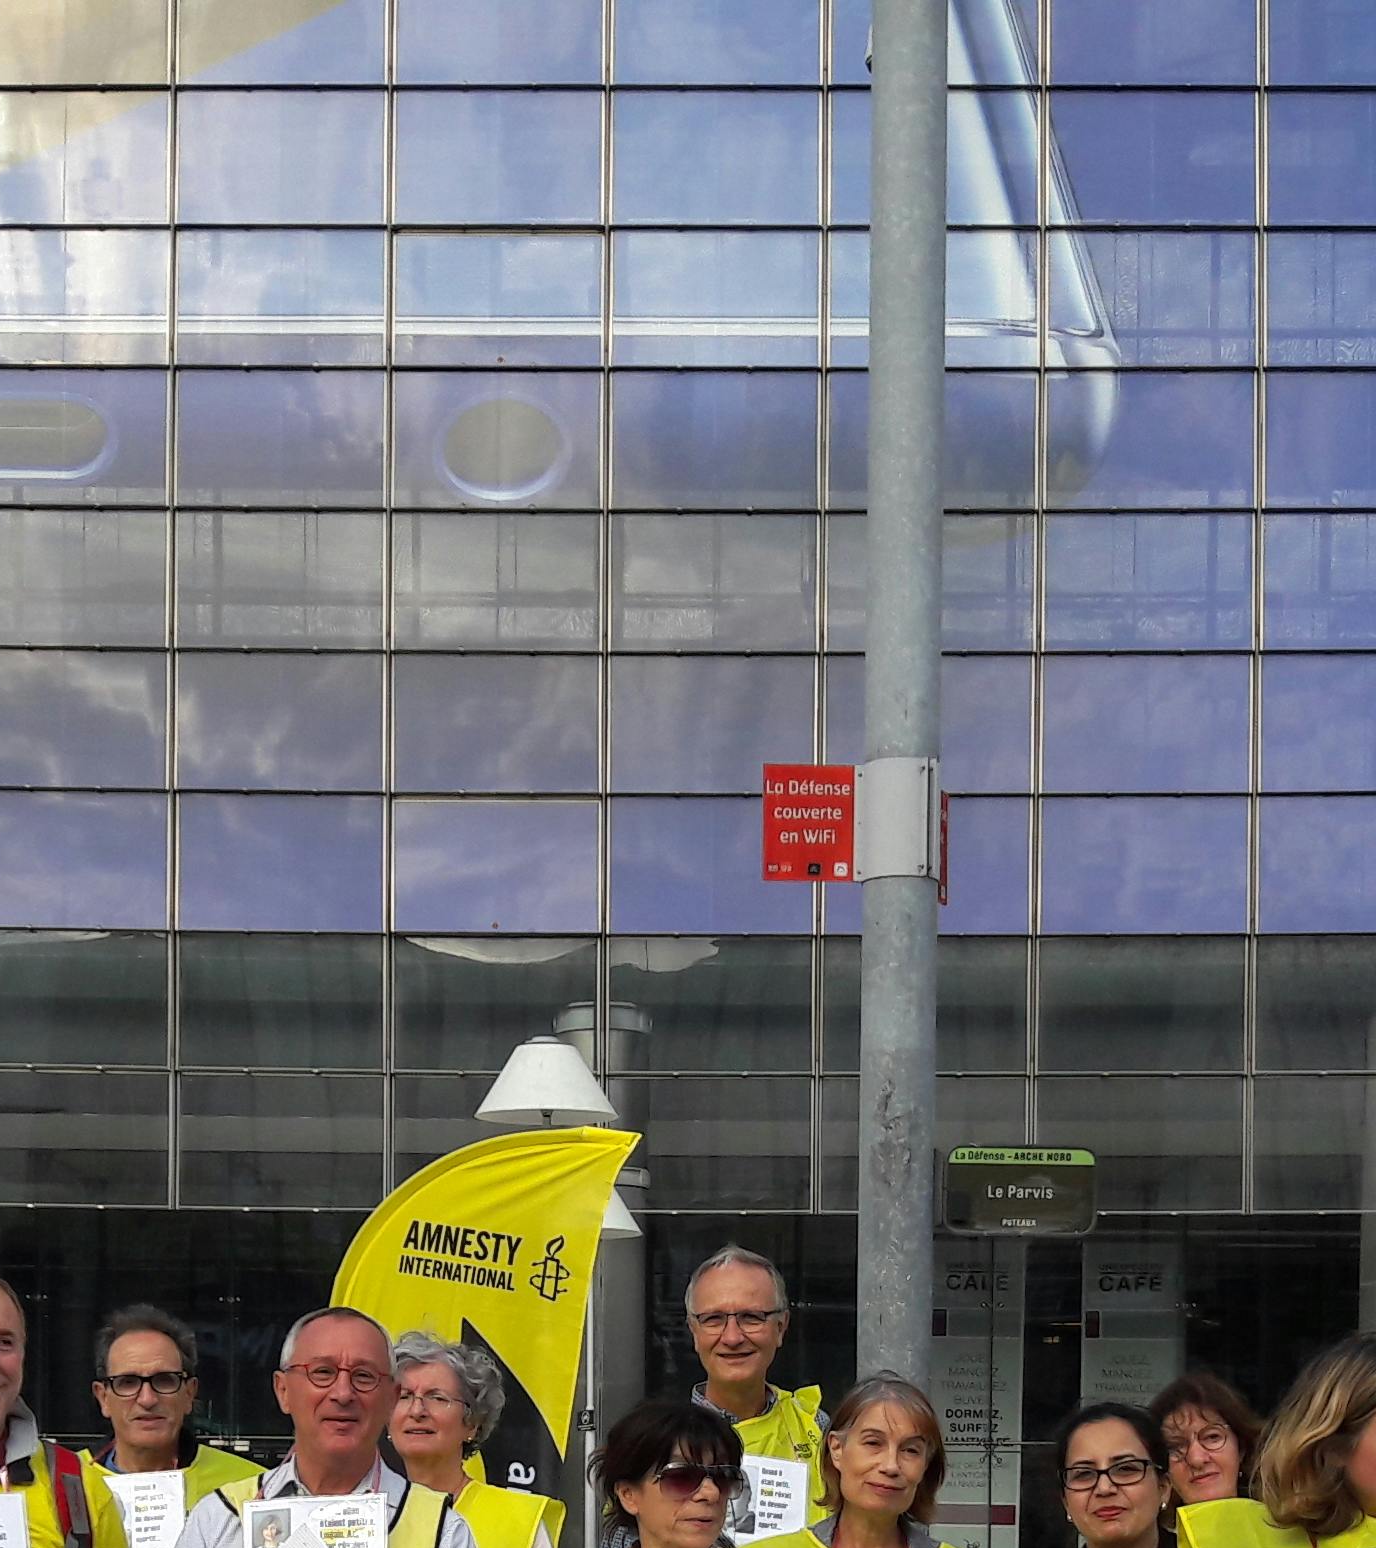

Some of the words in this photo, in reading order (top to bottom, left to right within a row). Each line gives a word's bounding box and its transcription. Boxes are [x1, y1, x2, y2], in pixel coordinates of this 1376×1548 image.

[766, 780, 784, 795] La
[788, 780, 850, 796] Défense
[774, 806, 843, 820] couverte
[780, 831, 799, 844] en
[802, 828, 836, 844] WiFi
[954, 1151, 966, 1160] La
[968, 1150, 1005, 1161] Défense
[1014, 1152, 1044, 1161] ARCHE
[987, 1185, 1004, 1199] Le
[1008, 1184, 1054, 1199] Parvis
[1002, 1218, 1037, 1227] PUTEAUX
[402, 1220, 523, 1266] AMNESTY
[398, 1254, 516, 1292] INTERNATIONAL
